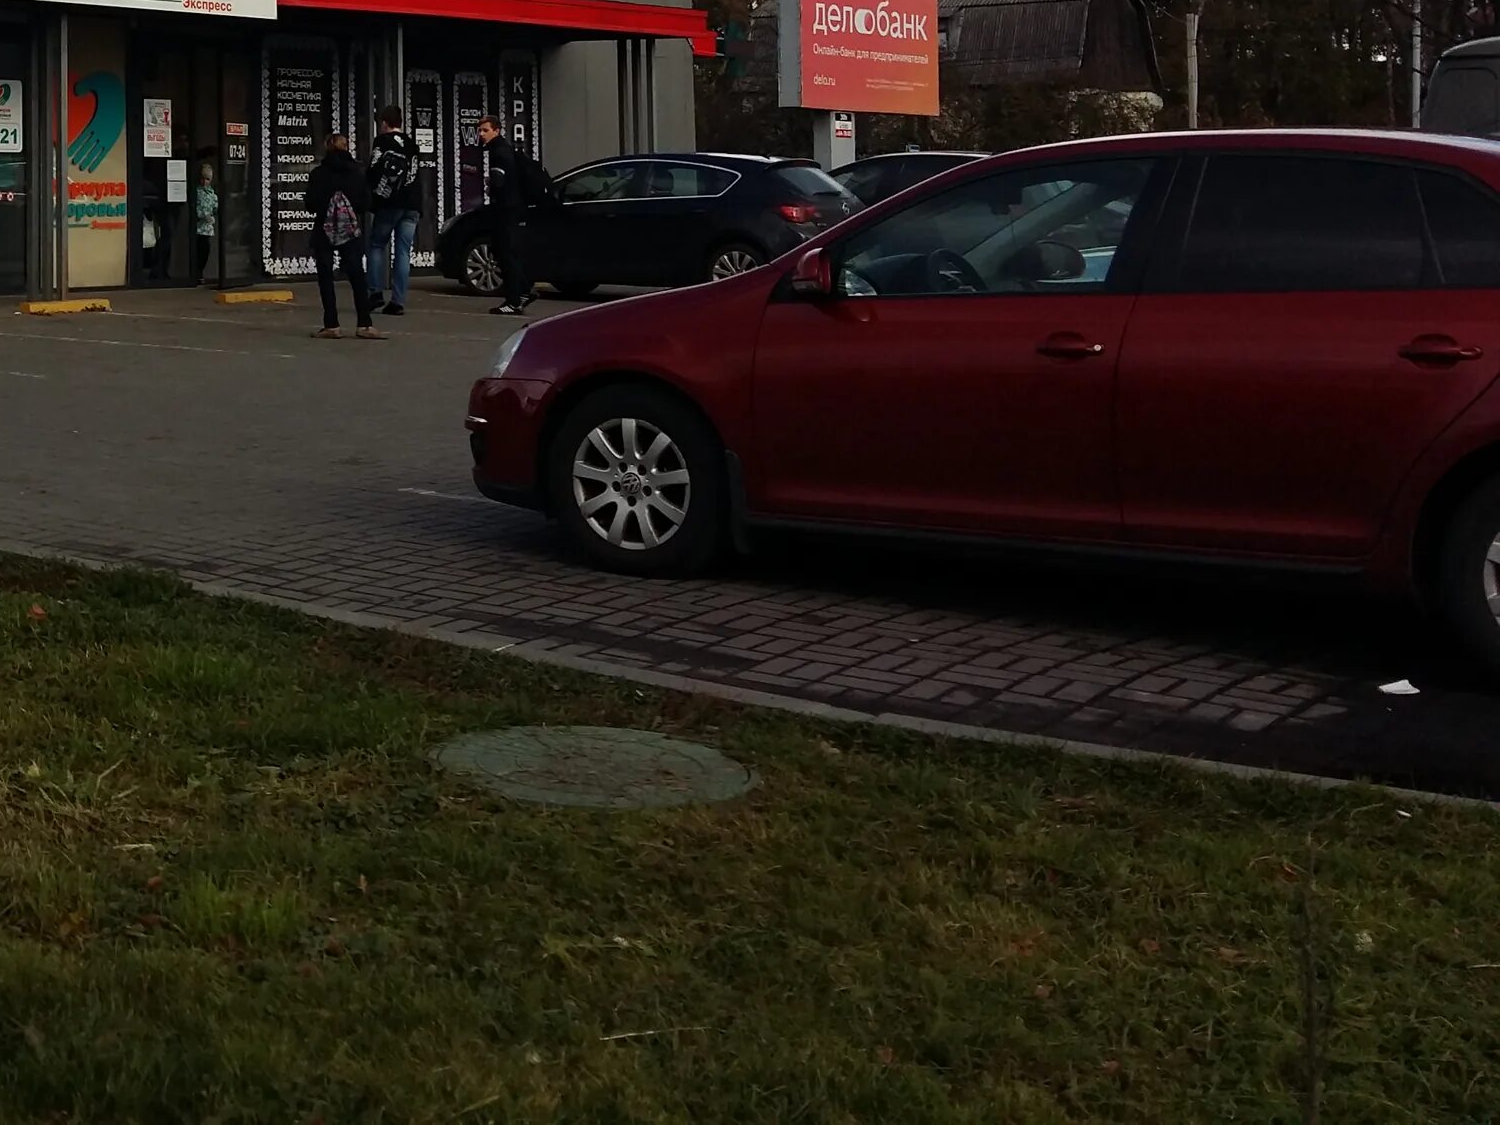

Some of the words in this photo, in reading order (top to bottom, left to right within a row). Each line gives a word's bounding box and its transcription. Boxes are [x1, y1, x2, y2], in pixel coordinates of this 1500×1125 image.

[812, 0, 929, 42] делобанк
[812, 43, 856, 58] Онлайн-банк
[856, 50, 869, 60] для
[813, 74, 836, 86] delo.ru
[277, 115, 309, 127] Matrix
[277, 134, 312, 146] СОЛЯРИЙ
[229, 144, 246, 159] 07-24
[277, 154, 315, 164] МАНИКЮР
[277, 173, 310, 183] ПЕДИКЮ
[68, 204, 126, 222] оровья
